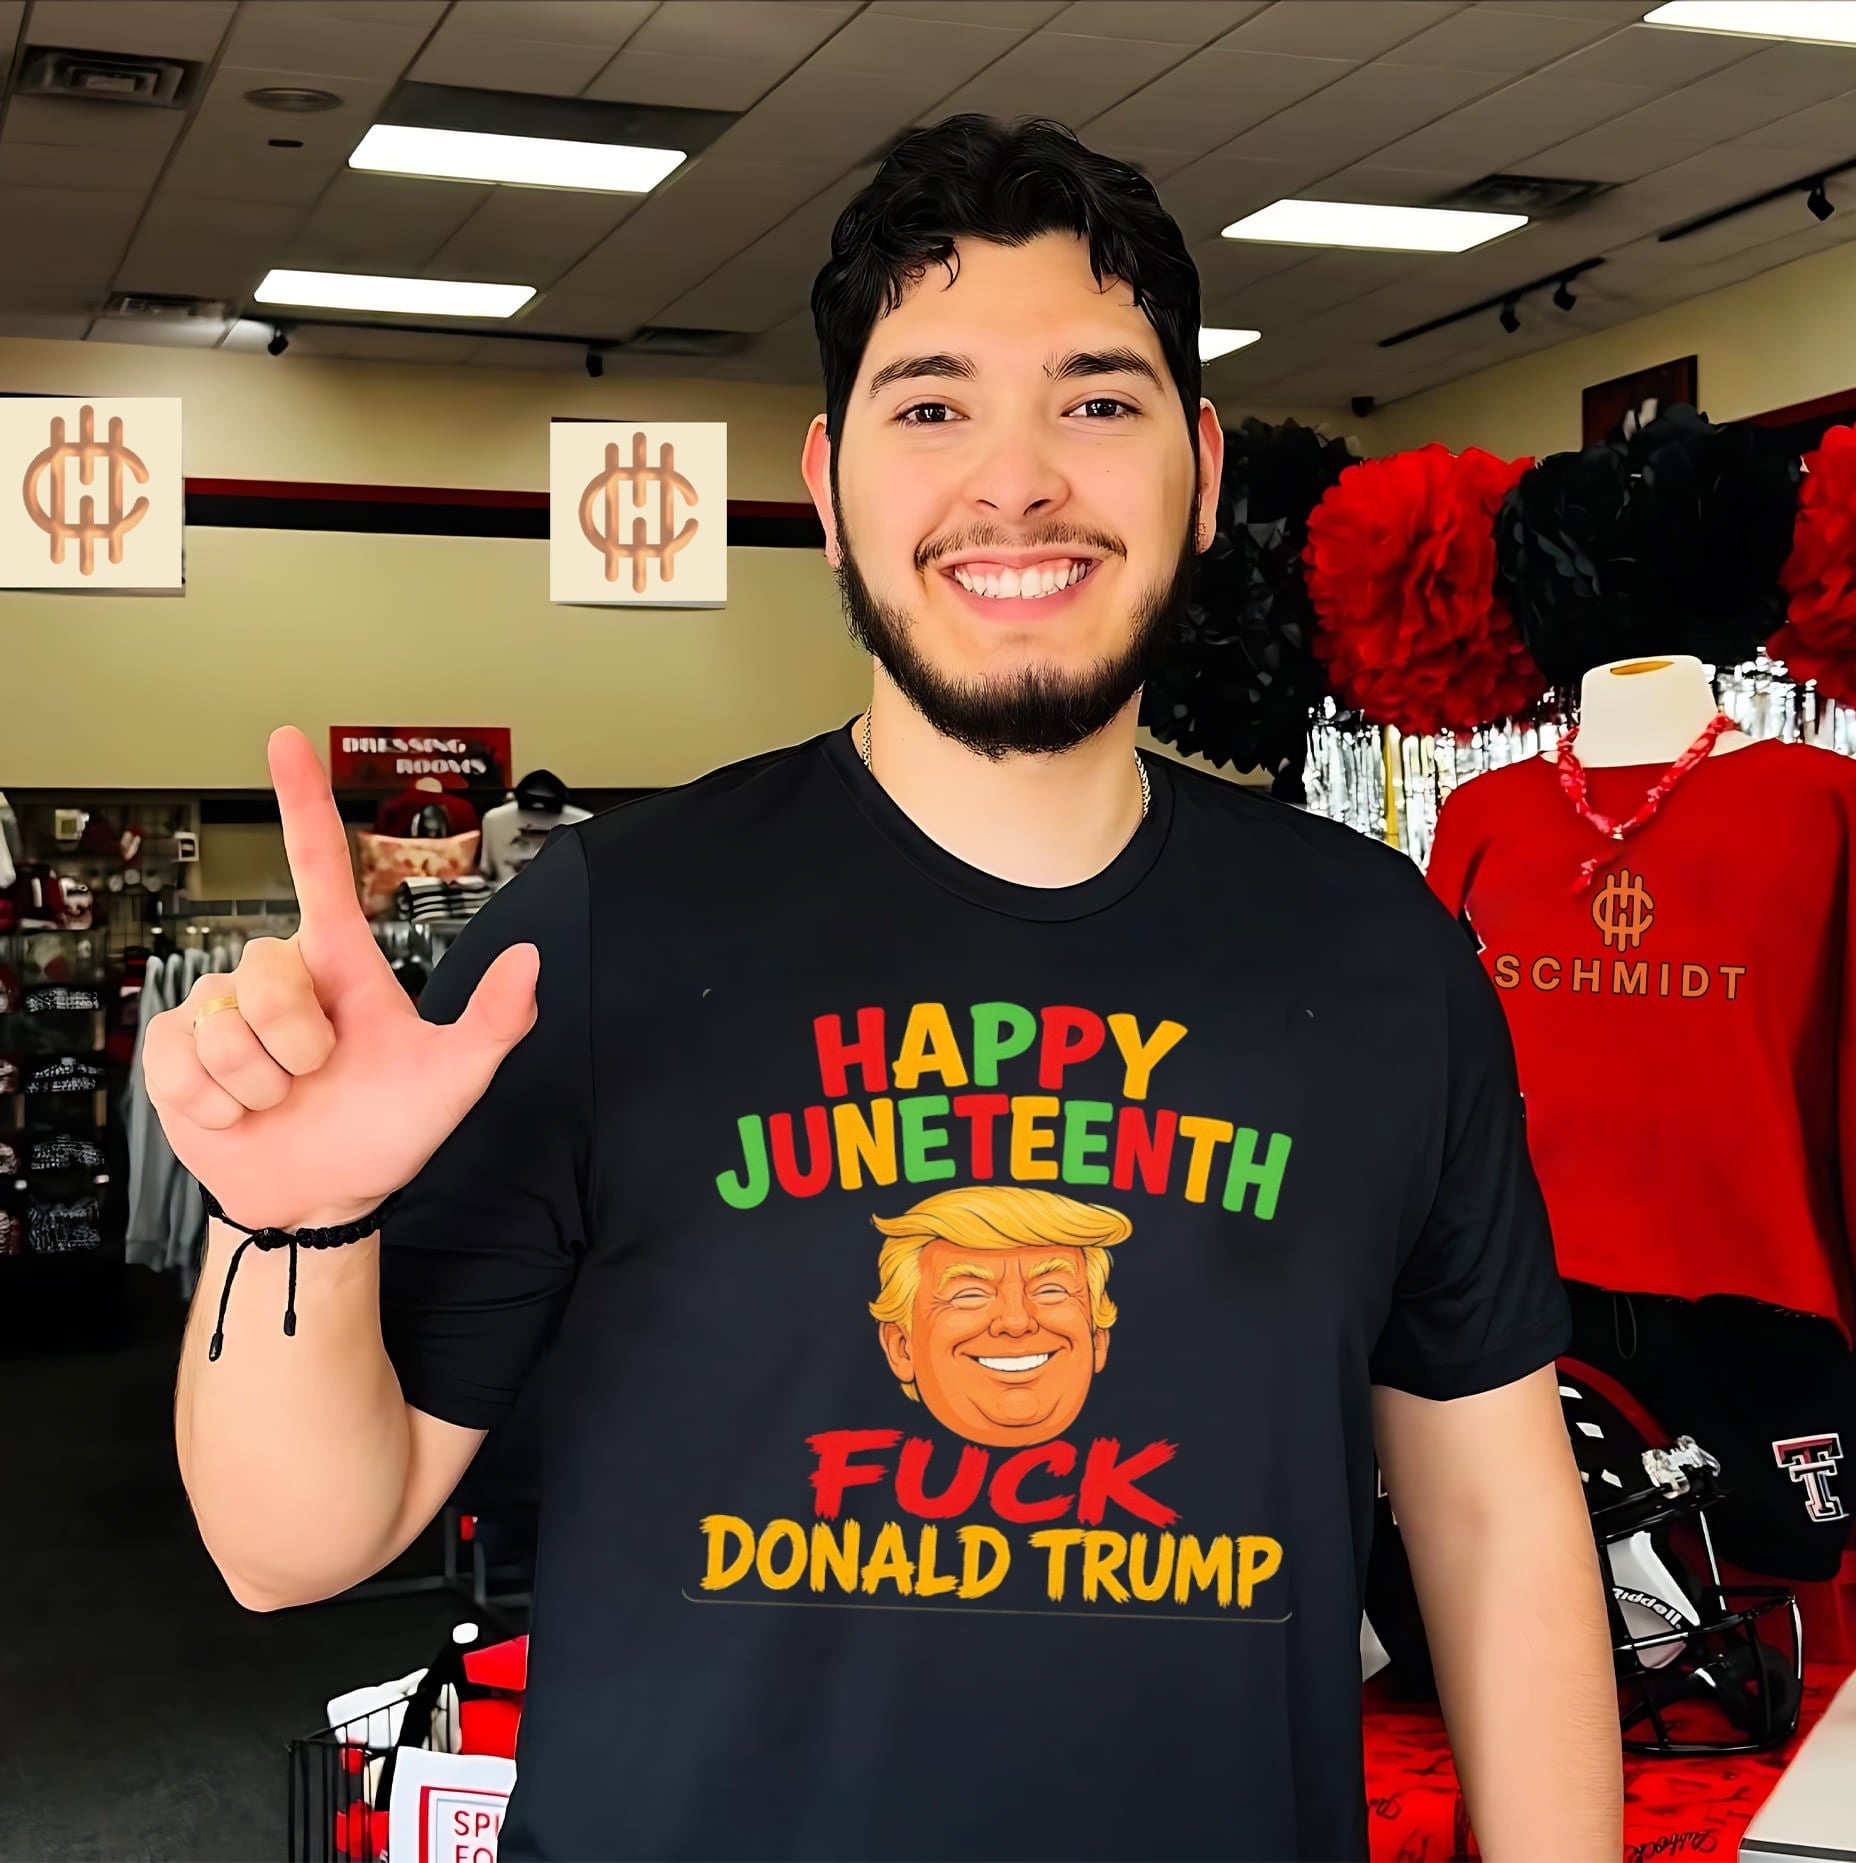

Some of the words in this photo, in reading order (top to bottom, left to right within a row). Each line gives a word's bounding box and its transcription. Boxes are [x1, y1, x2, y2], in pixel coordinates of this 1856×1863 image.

[342, 736, 467, 754] DRESSING
[396, 757, 488, 775] ROOMS
[1494, 953, 1747, 1001] SCHMIDT
[813, 1001, 1189, 1100] HAPPY
[715, 1093, 1293, 1221] JUNETEENTH
[805, 1427, 1183, 1529] FUCK
[699, 1514, 1012, 1600] DONALD
[1027, 1526, 1284, 1610] TRUMP
